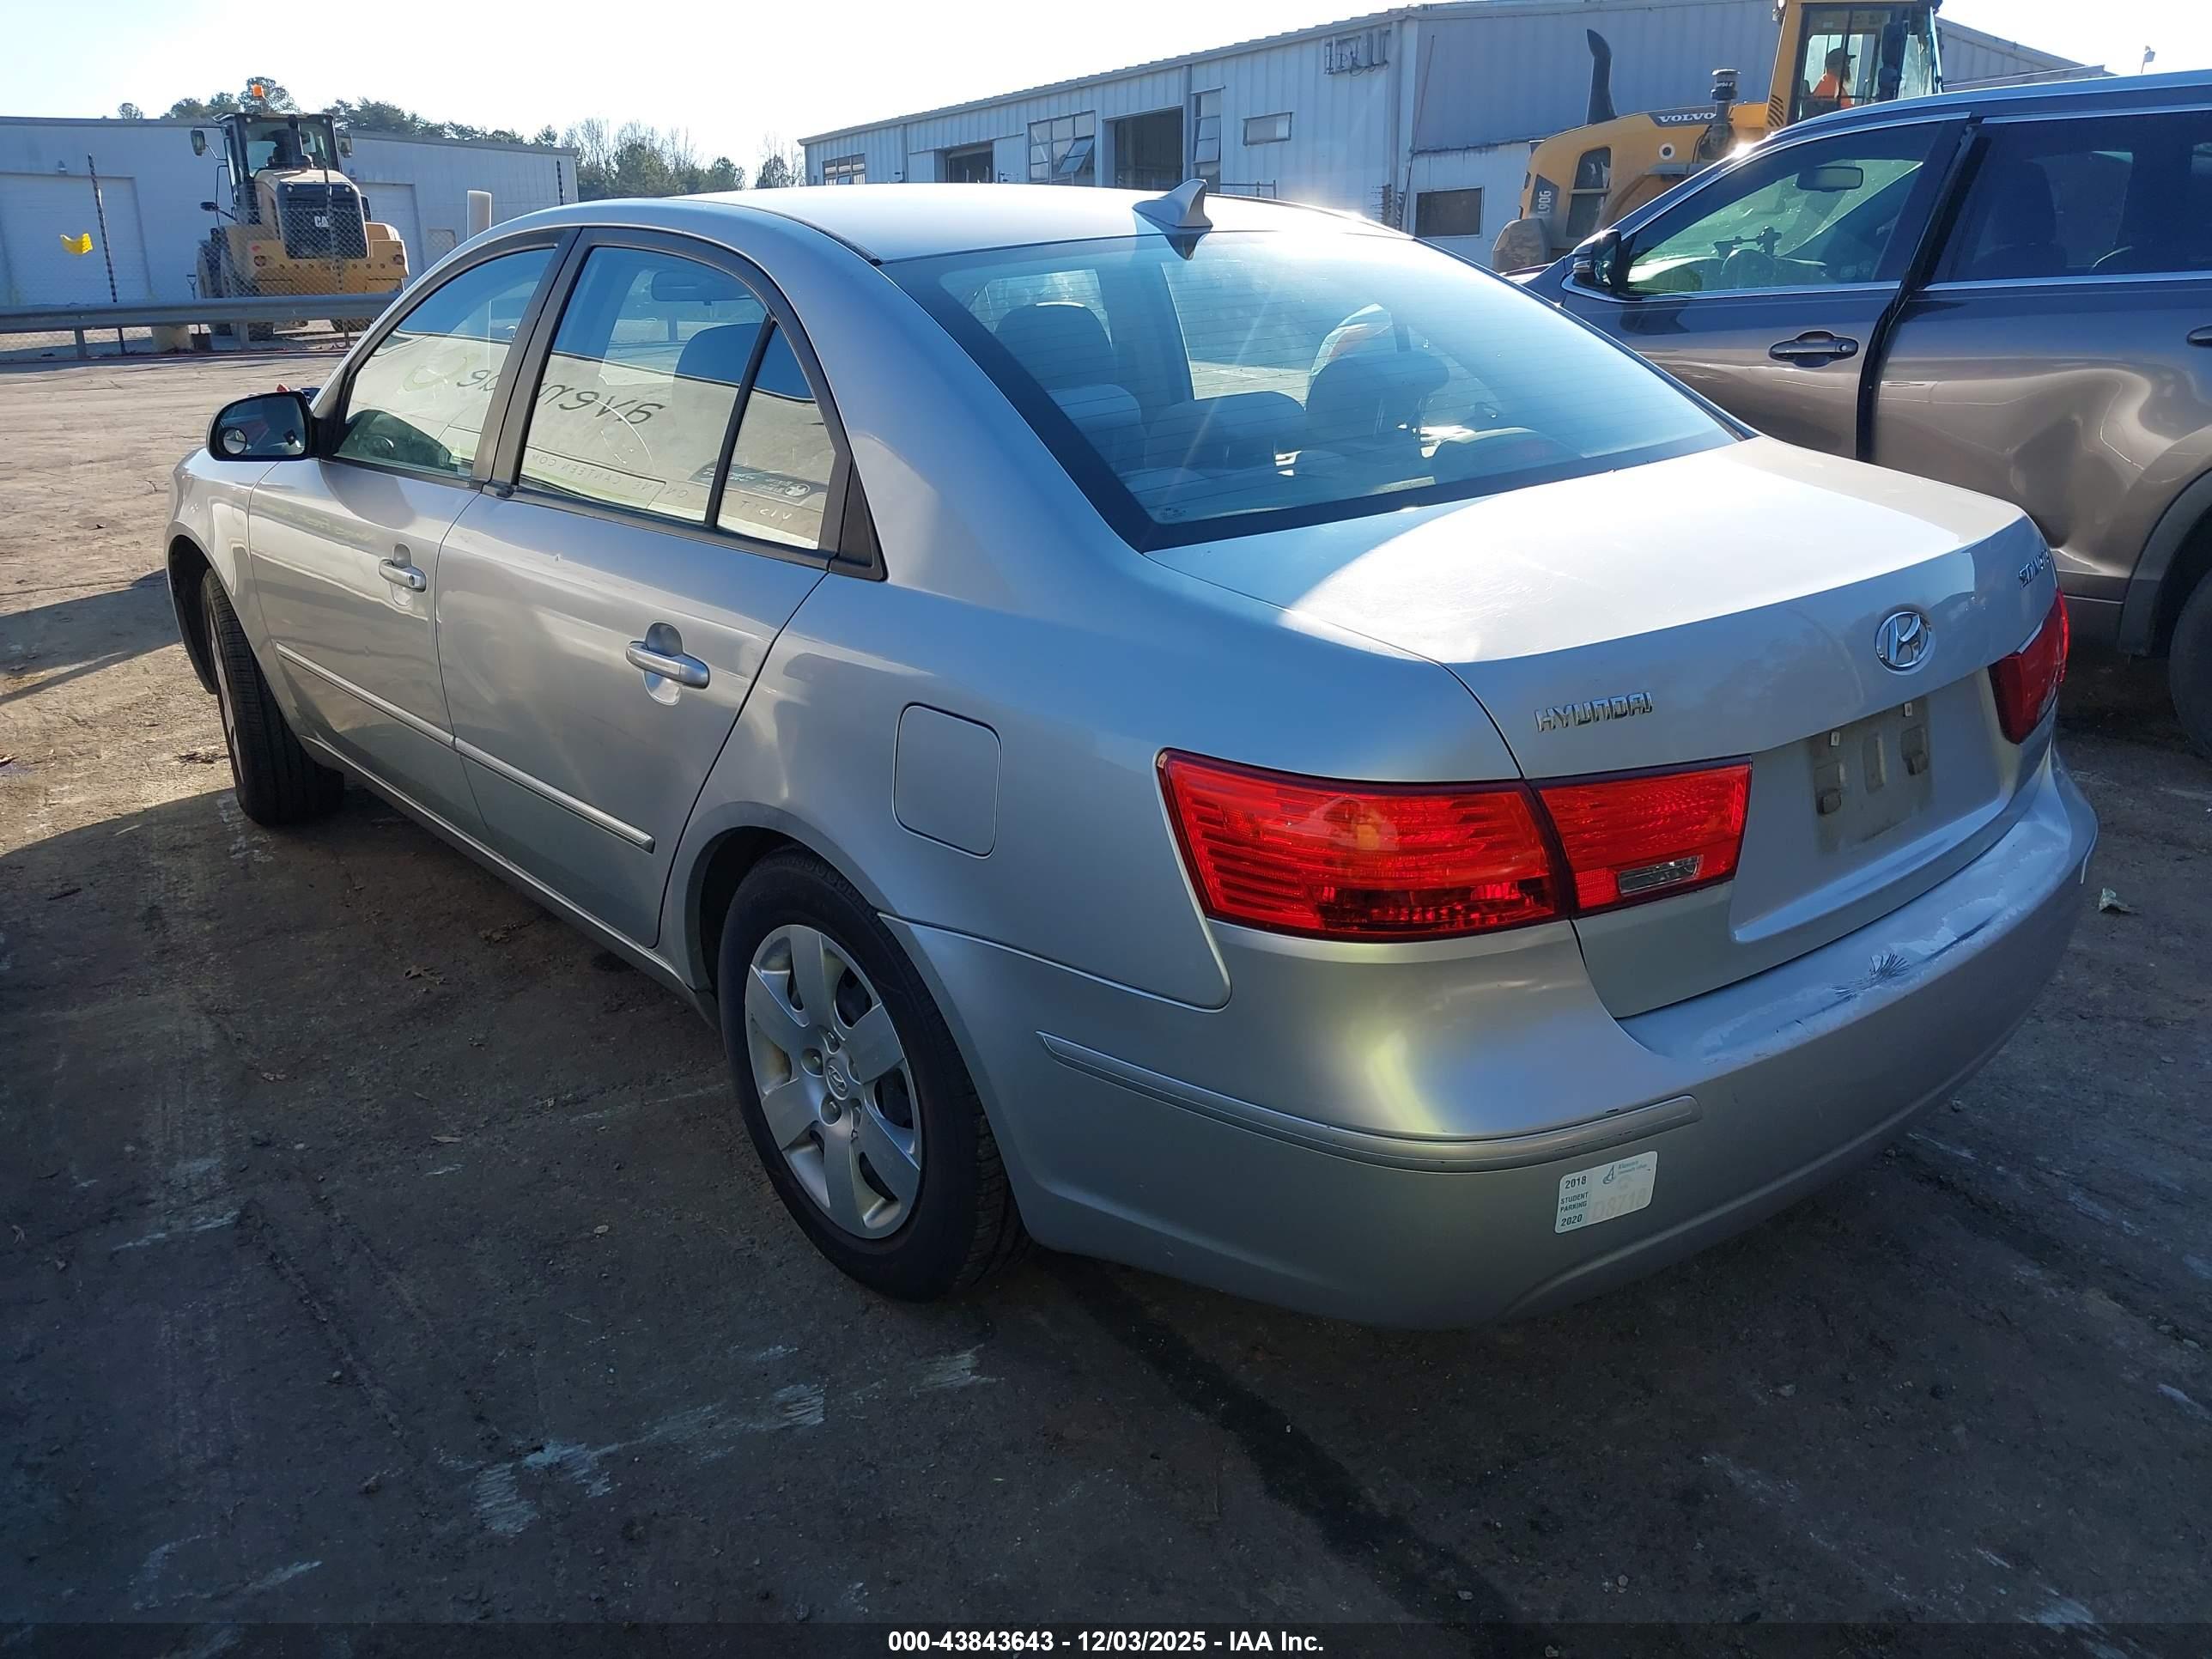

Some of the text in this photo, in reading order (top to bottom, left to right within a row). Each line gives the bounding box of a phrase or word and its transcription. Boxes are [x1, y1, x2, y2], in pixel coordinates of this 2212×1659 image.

[1658, 112, 1717, 124] VOLVO
[1537, 190, 1553, 215] L90G
[313, 216, 331, 228] CA
[1534, 691, 1653, 732] HYUNDAI
[1565, 1175, 1587, 1189] 2018
[1560, 1191, 1589, 1205] STUDENT
[1559, 1200, 1588, 1213] PARKING
[1560, 1213, 1583, 1227] 2020
